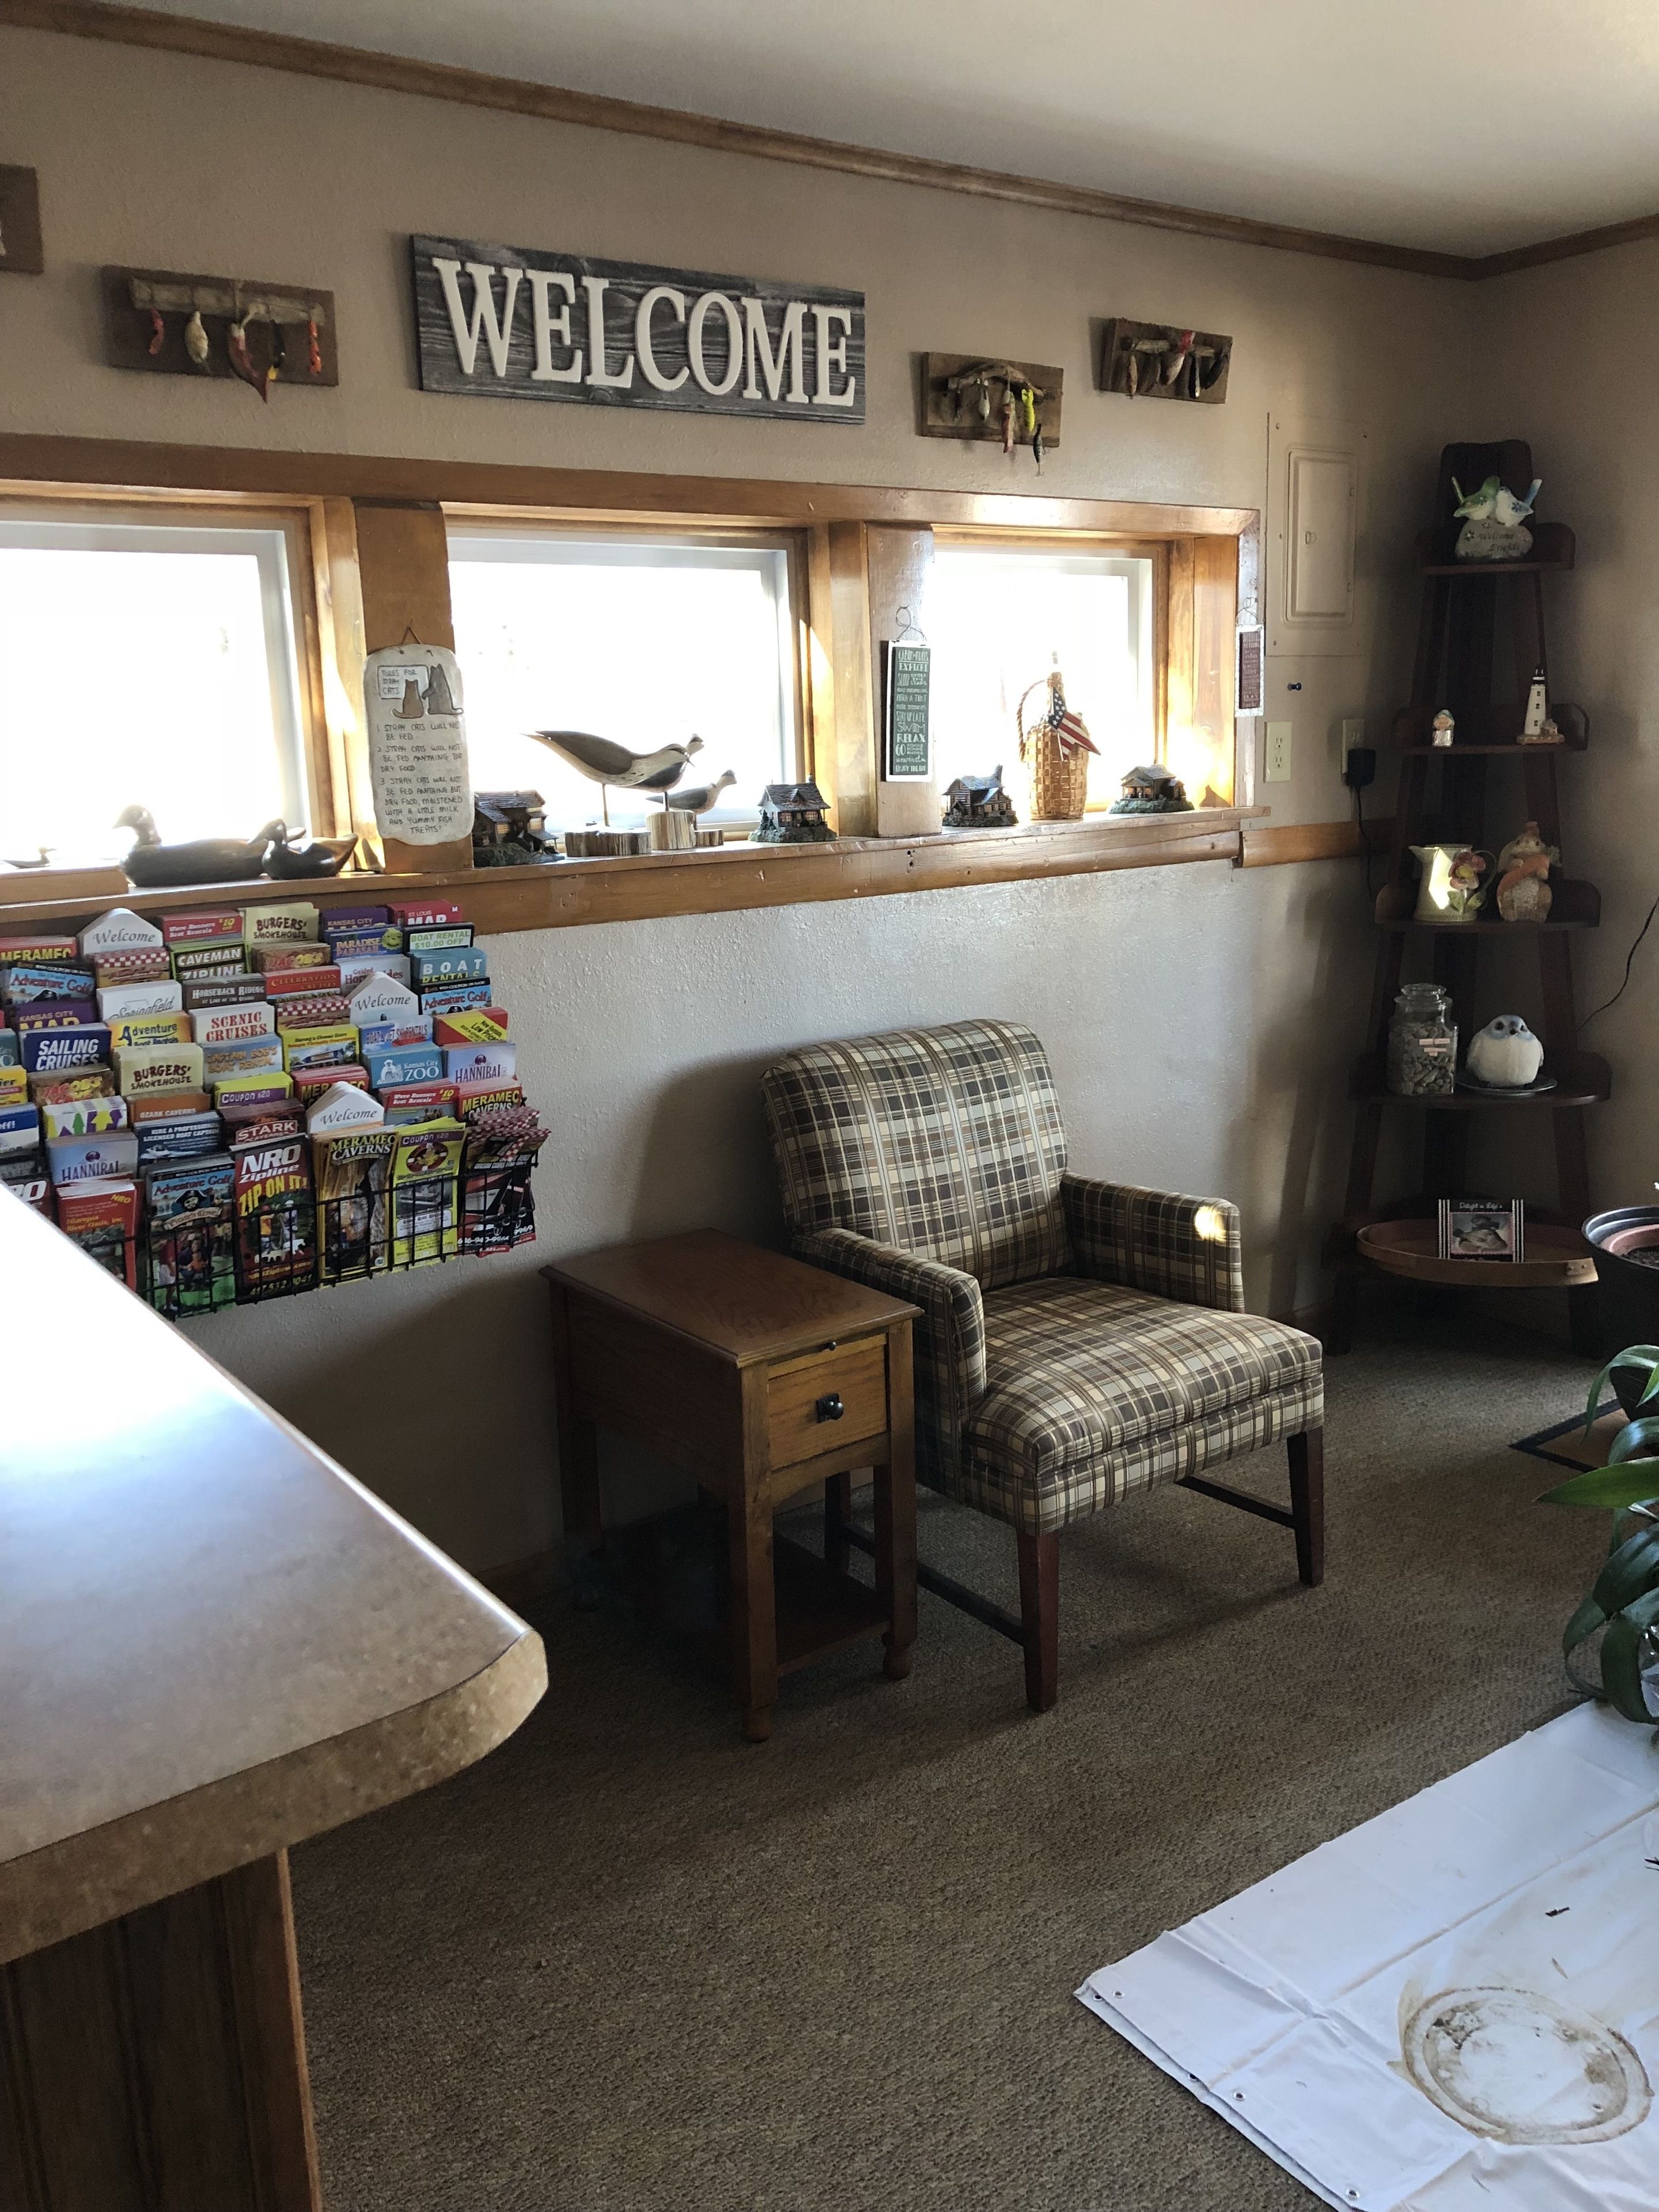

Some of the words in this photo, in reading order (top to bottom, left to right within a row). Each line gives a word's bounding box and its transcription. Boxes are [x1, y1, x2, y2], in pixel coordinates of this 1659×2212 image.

[431, 257, 855, 407] WELCOME
[897, 733, 926, 743] RELAX
[414, 753, 449, 762] ANYTHING
[385, 787, 395, 796] BE
[422, 796, 463, 804] MOISTENED
[256, 916, 306, 931] BURGERS'
[93, 928, 156, 944] Welcome
[253, 931, 308, 939] SMOKEHOUSE
[336, 938, 381, 948] PARADISE
[411, 934, 433, 942] BOAT
[437, 931, 470, 940] RENTAL
[415, 941, 444, 949] $10.00
[177, 948, 242, 967] CAVEMAN
[423, 959, 482, 975] BOAT
[271, 974, 337, 987] CELEBRATION
[192, 987, 235, 999] HORSEBACK
[238, 986, 264, 996] RIDING
[425, 996, 465, 1010] Adventure
[467, 991, 488, 1002] Golf
[355, 993, 411, 1010] Welcome
[20, 1012, 52, 1022] KANSAS
[55, 1010, 74, 1018] CITY
[211, 1012, 262, 1029] SCENIC
[118, 1023, 178, 1046] Adventure
[206, 1023, 267, 1042] CRUISES
[406, 1024, 428, 1037] RENTALS
[471, 1022, 483, 1033] Low
[38, 1039, 99, 1055] SAILING
[36, 1054, 100, 1070] CRUISES
[133, 1065, 191, 1082] BURGERS'
[404, 1066, 439, 1081] ZOO
[130, 1076, 192, 1090] SMOKEHOUSE
[440, 1089, 454, 1097] $10
[463, 1090, 520, 1112] MERAMEC
[320, 1108, 378, 1124] Welcome
[143, 1134, 175, 1142] LICENSED
[238, 1123, 294, 1140] STARK
[331, 1135, 396, 1152] MERAMEC
[241, 1145, 301, 1175] NRO
[332, 1144, 391, 1161] CAVERNS
[239, 1165, 300, 1184] Zipline
[154, 1180, 205, 1196] Adventure
[239, 1184, 262, 1217] ZIP
[266, 1175, 285, 1198] ON
[289, 1175, 308, 1190] IT!
[111, 1194, 131, 1203] NRO
